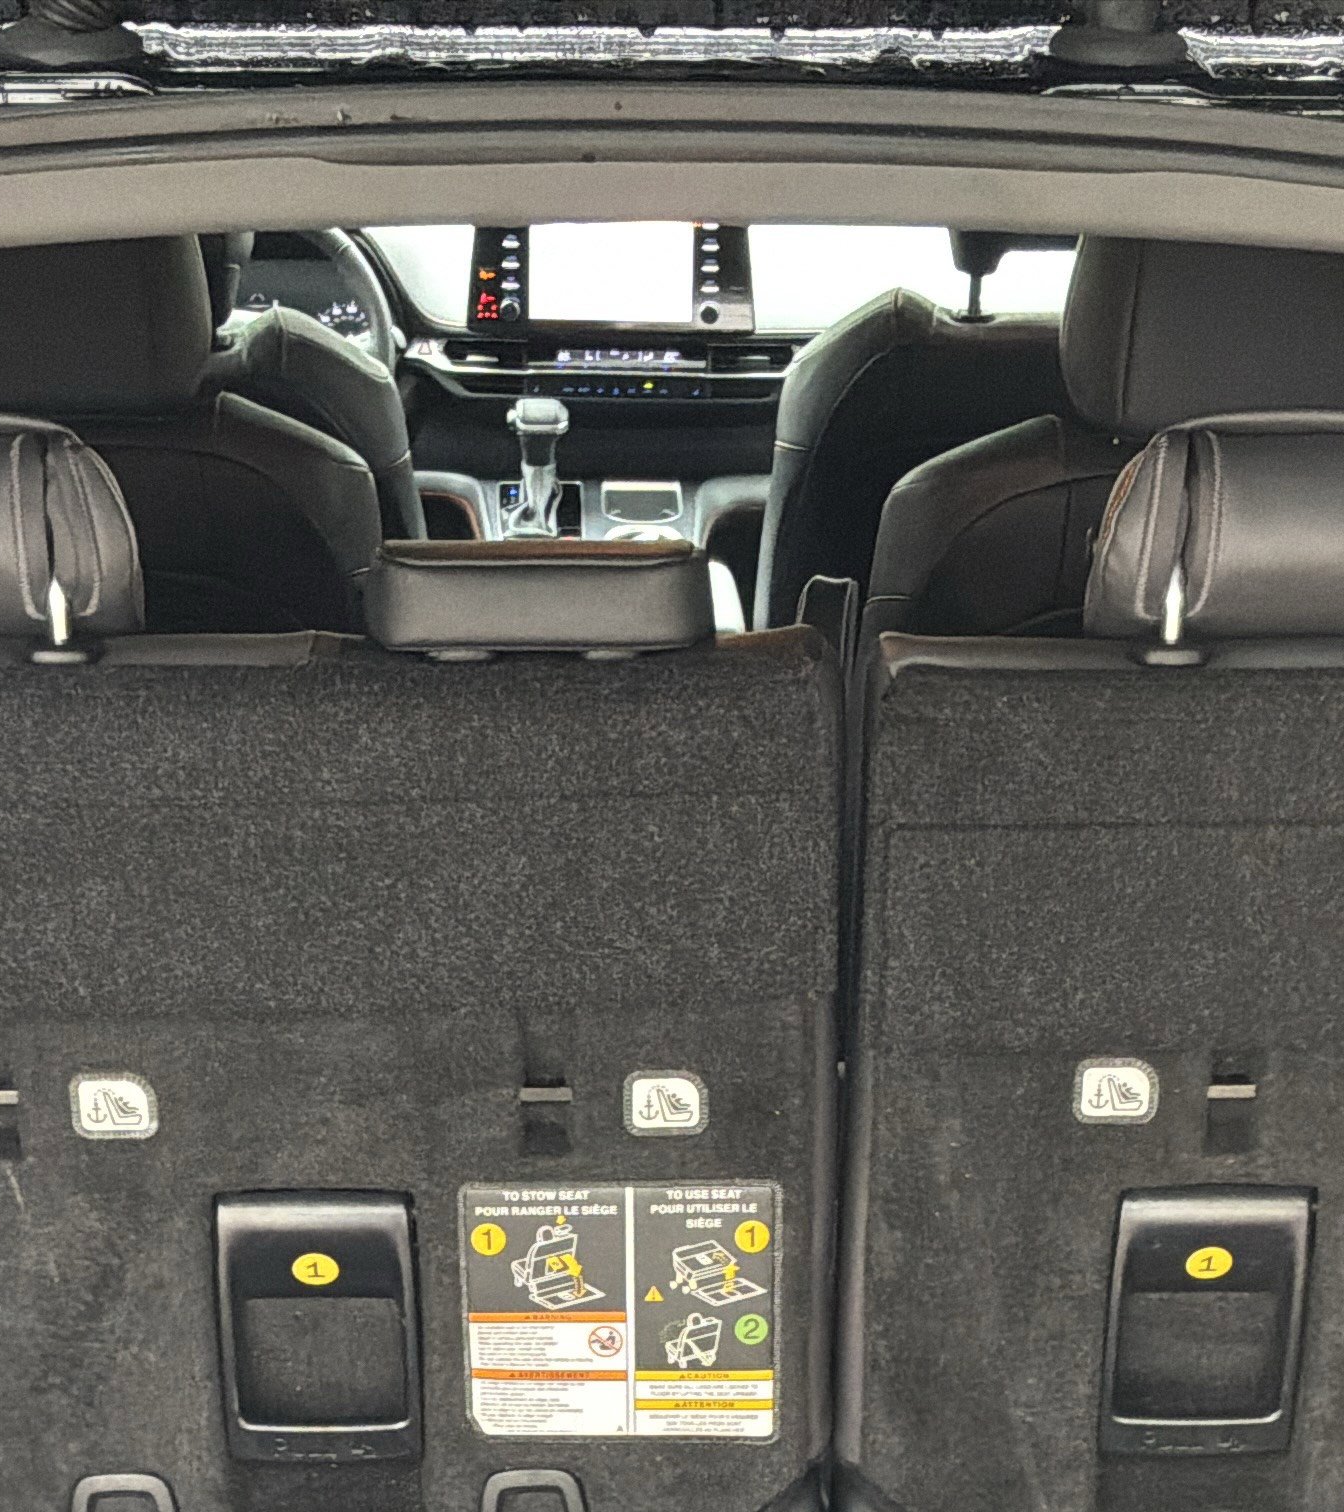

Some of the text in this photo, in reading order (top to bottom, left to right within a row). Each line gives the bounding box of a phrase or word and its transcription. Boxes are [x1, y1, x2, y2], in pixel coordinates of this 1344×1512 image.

[502, 1189, 591, 1202] TO STOW SEAT
[666, 1188, 742, 1200] TO USE SEAT
[475, 1203, 618, 1217] POUR RANGER LE SIÈGE
[650, 1202, 759, 1215] POUR UTILISER LE
[685, 1216, 723, 1229] SIÈGE
[743, 1317, 761, 1340] 2
